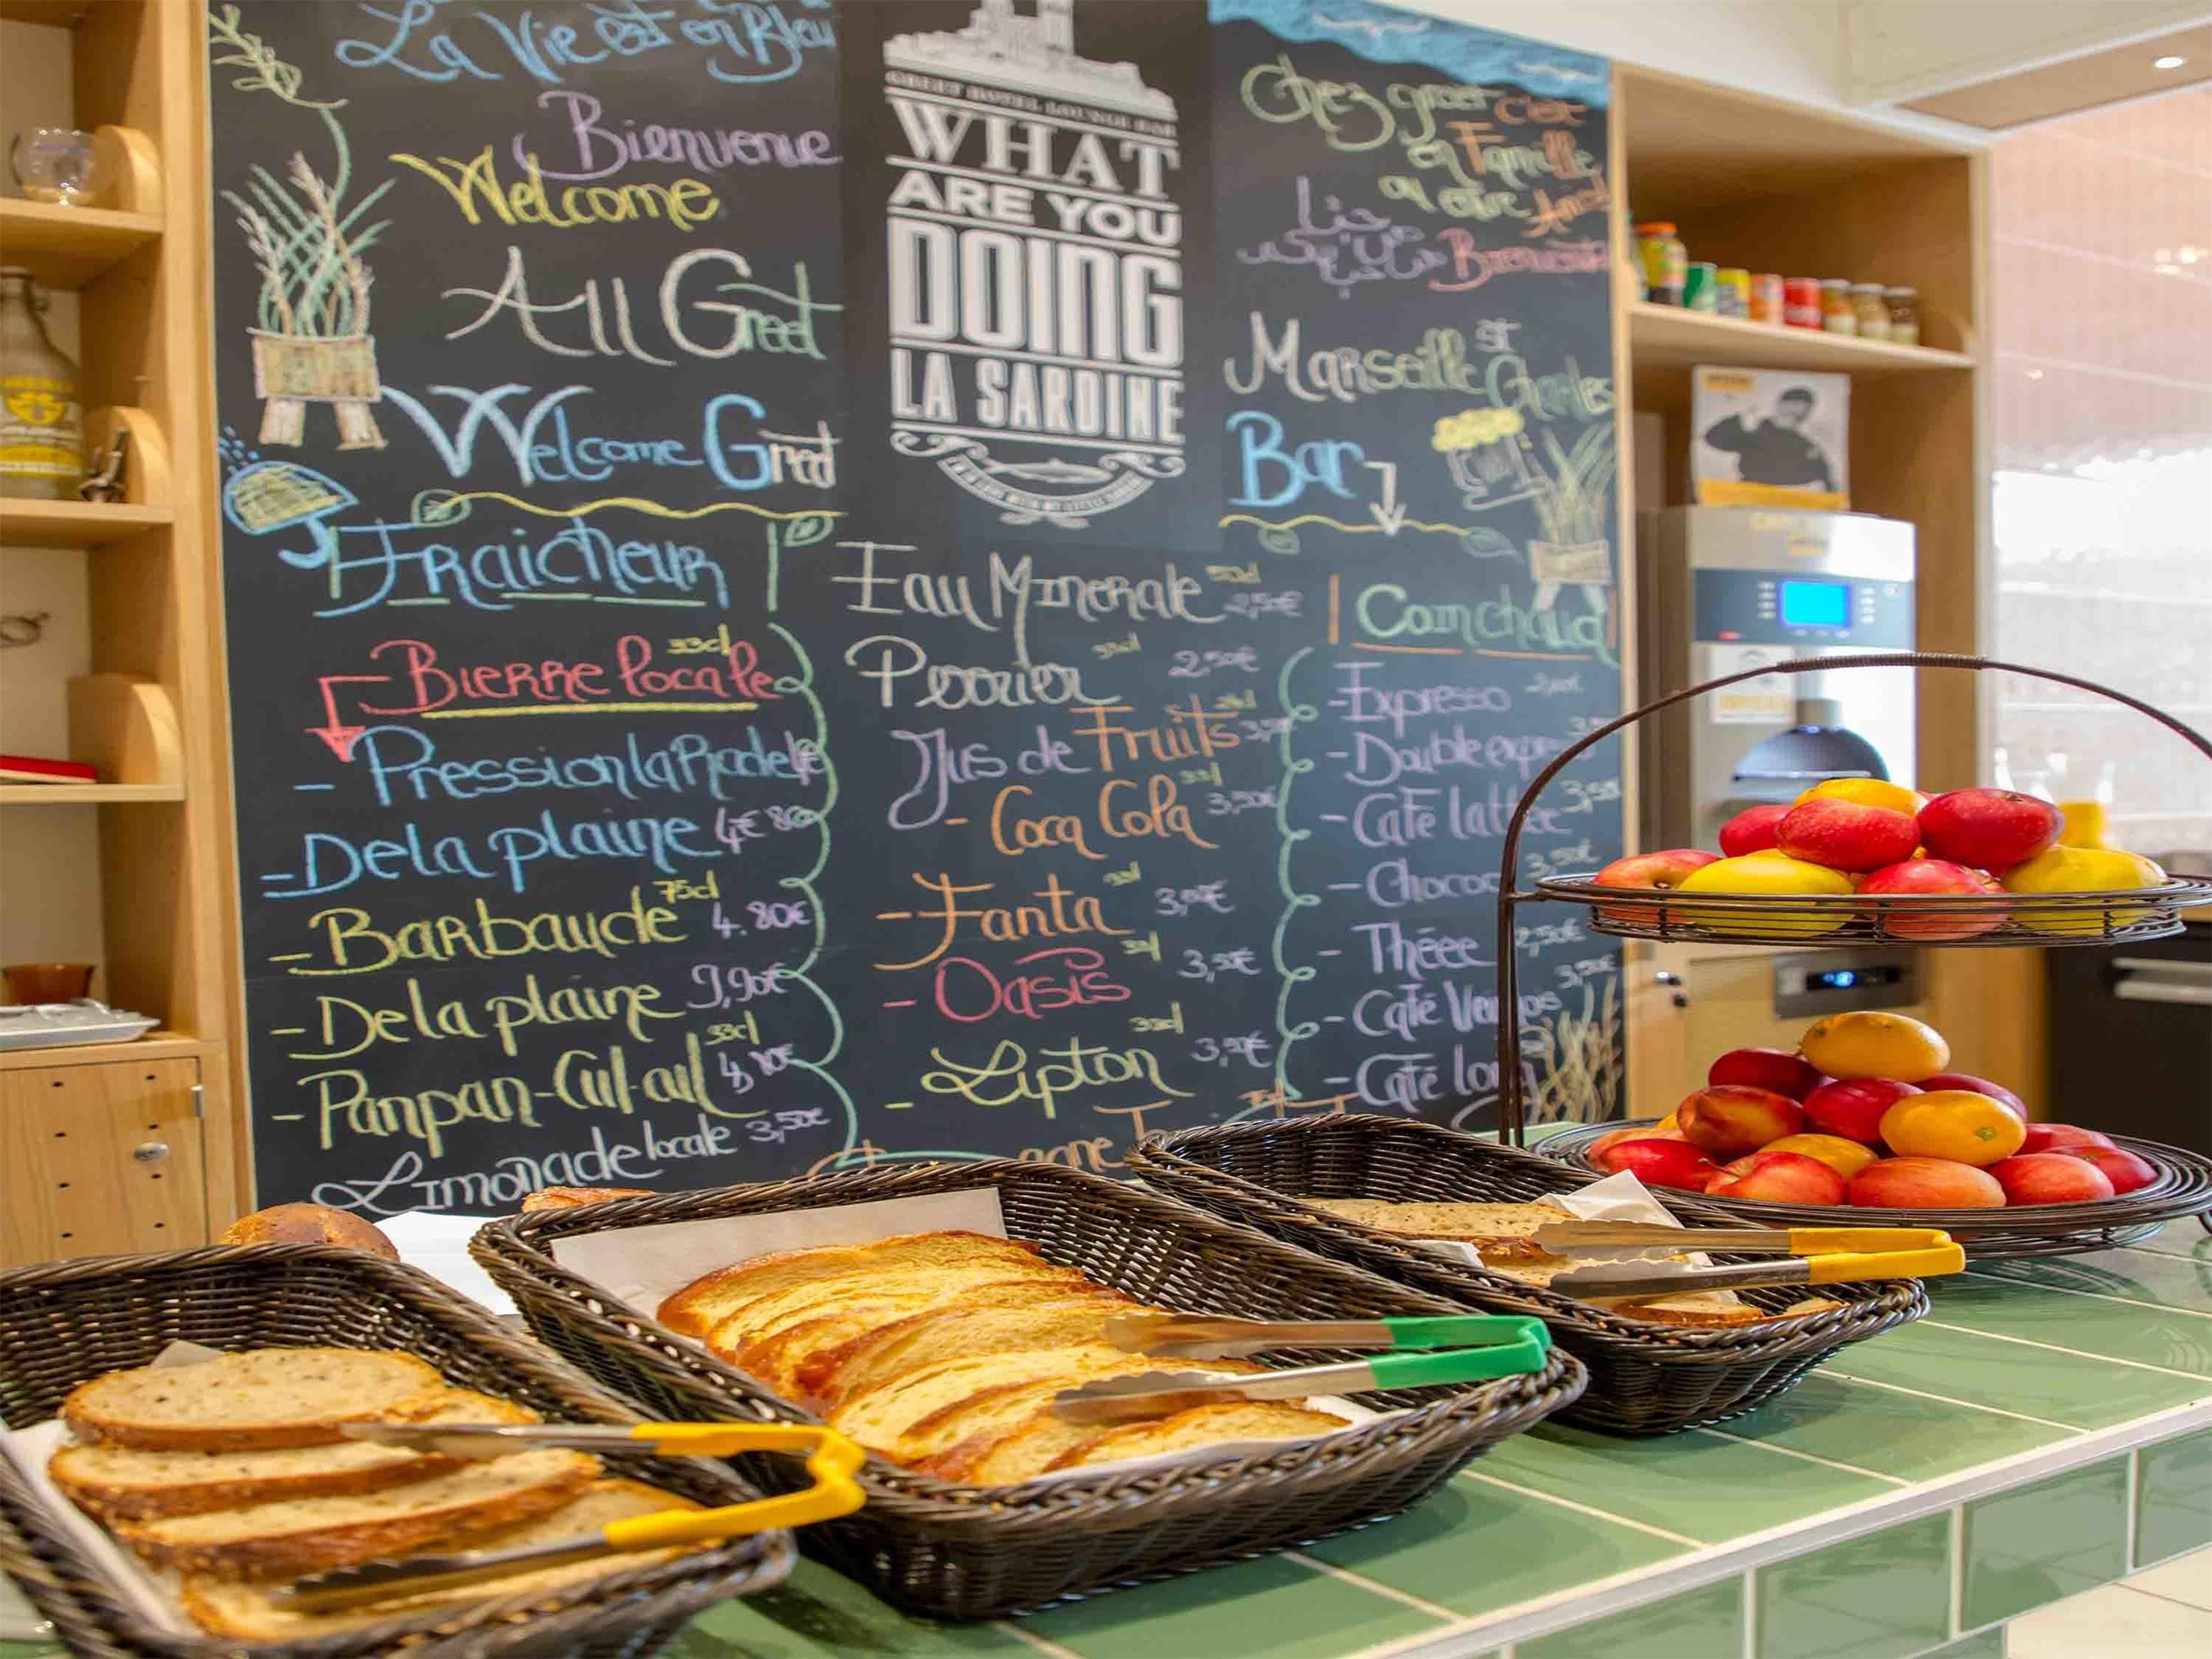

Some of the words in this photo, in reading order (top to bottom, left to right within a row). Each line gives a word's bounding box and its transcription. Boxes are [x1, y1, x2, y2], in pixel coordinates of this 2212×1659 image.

[472, 11, 610, 83] Vie
[388, 144, 720, 231] Welcome
[886, 95, 1181, 200] WHAT
[887, 168, 1036, 226] ARE
[1045, 192, 1182, 248] YOU
[440, 245, 678, 367] All
[887, 216, 1184, 369] DOING
[381, 383, 705, 488] Welcome
[889, 348, 959, 423] LA
[975, 357, 1186, 445] SARDINE
[1225, 409, 1366, 508] Bar
[1018, 725, 1092, 774] de
[1069, 693, 1241, 773] Fruits
[990, 784, 1111, 861] Coca
[1098, 773, 1220, 850] Cola
[873, 872, 1136, 970] Fanta
[934, 945, 1133, 1023] Oasis
[921, 1038, 1197, 1120] Lipton
[310, 1126, 664, 1216] Limonade
